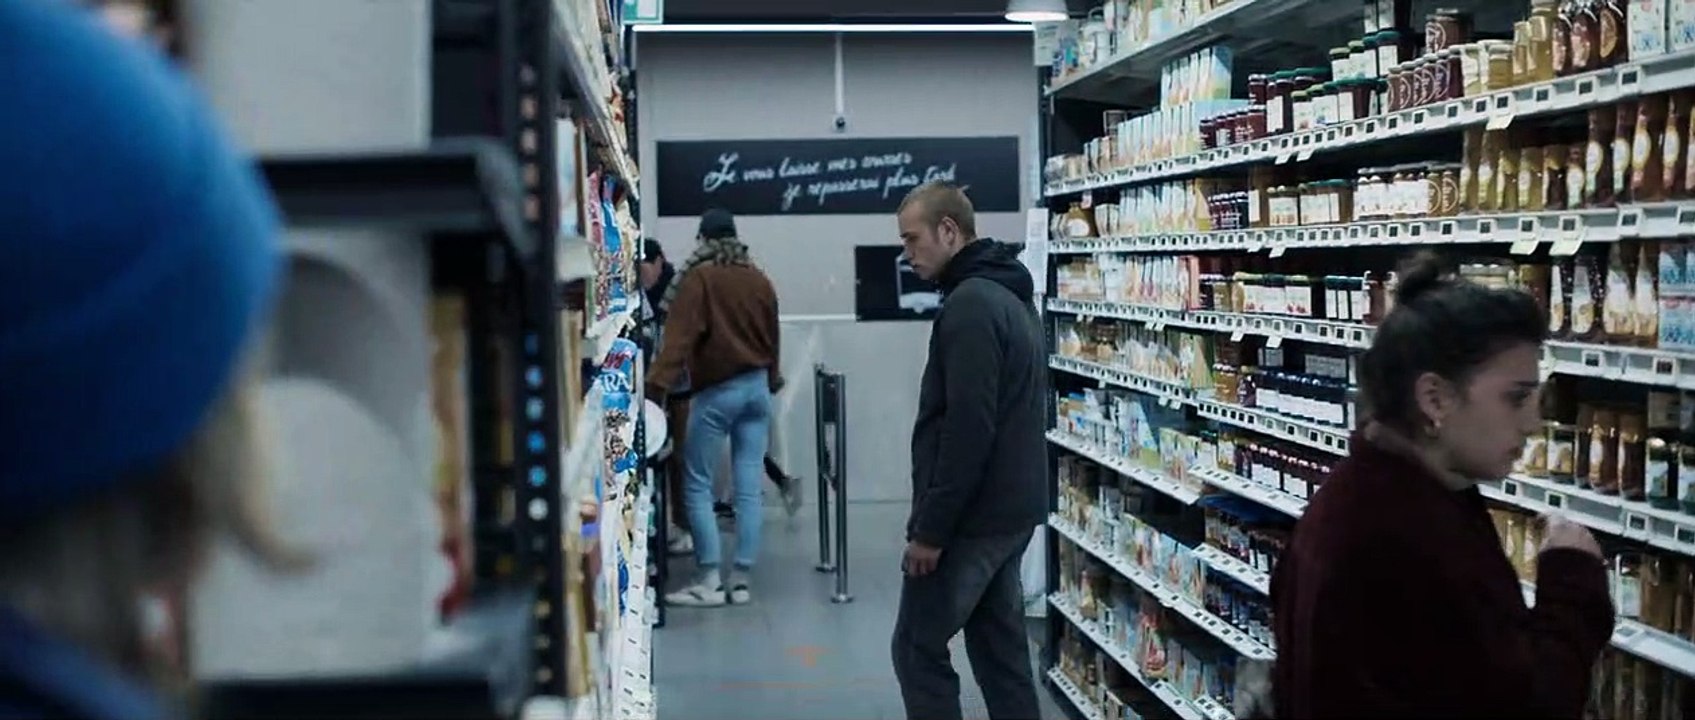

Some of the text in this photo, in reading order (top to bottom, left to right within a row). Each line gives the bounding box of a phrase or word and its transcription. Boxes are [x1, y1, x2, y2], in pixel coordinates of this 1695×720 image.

[703, 152, 739, 192] Je
[743, 167, 774, 181] vous
[778, 156, 820, 178] laisse
[827, 157, 857, 171] mes
[882, 166, 920, 199] plus
